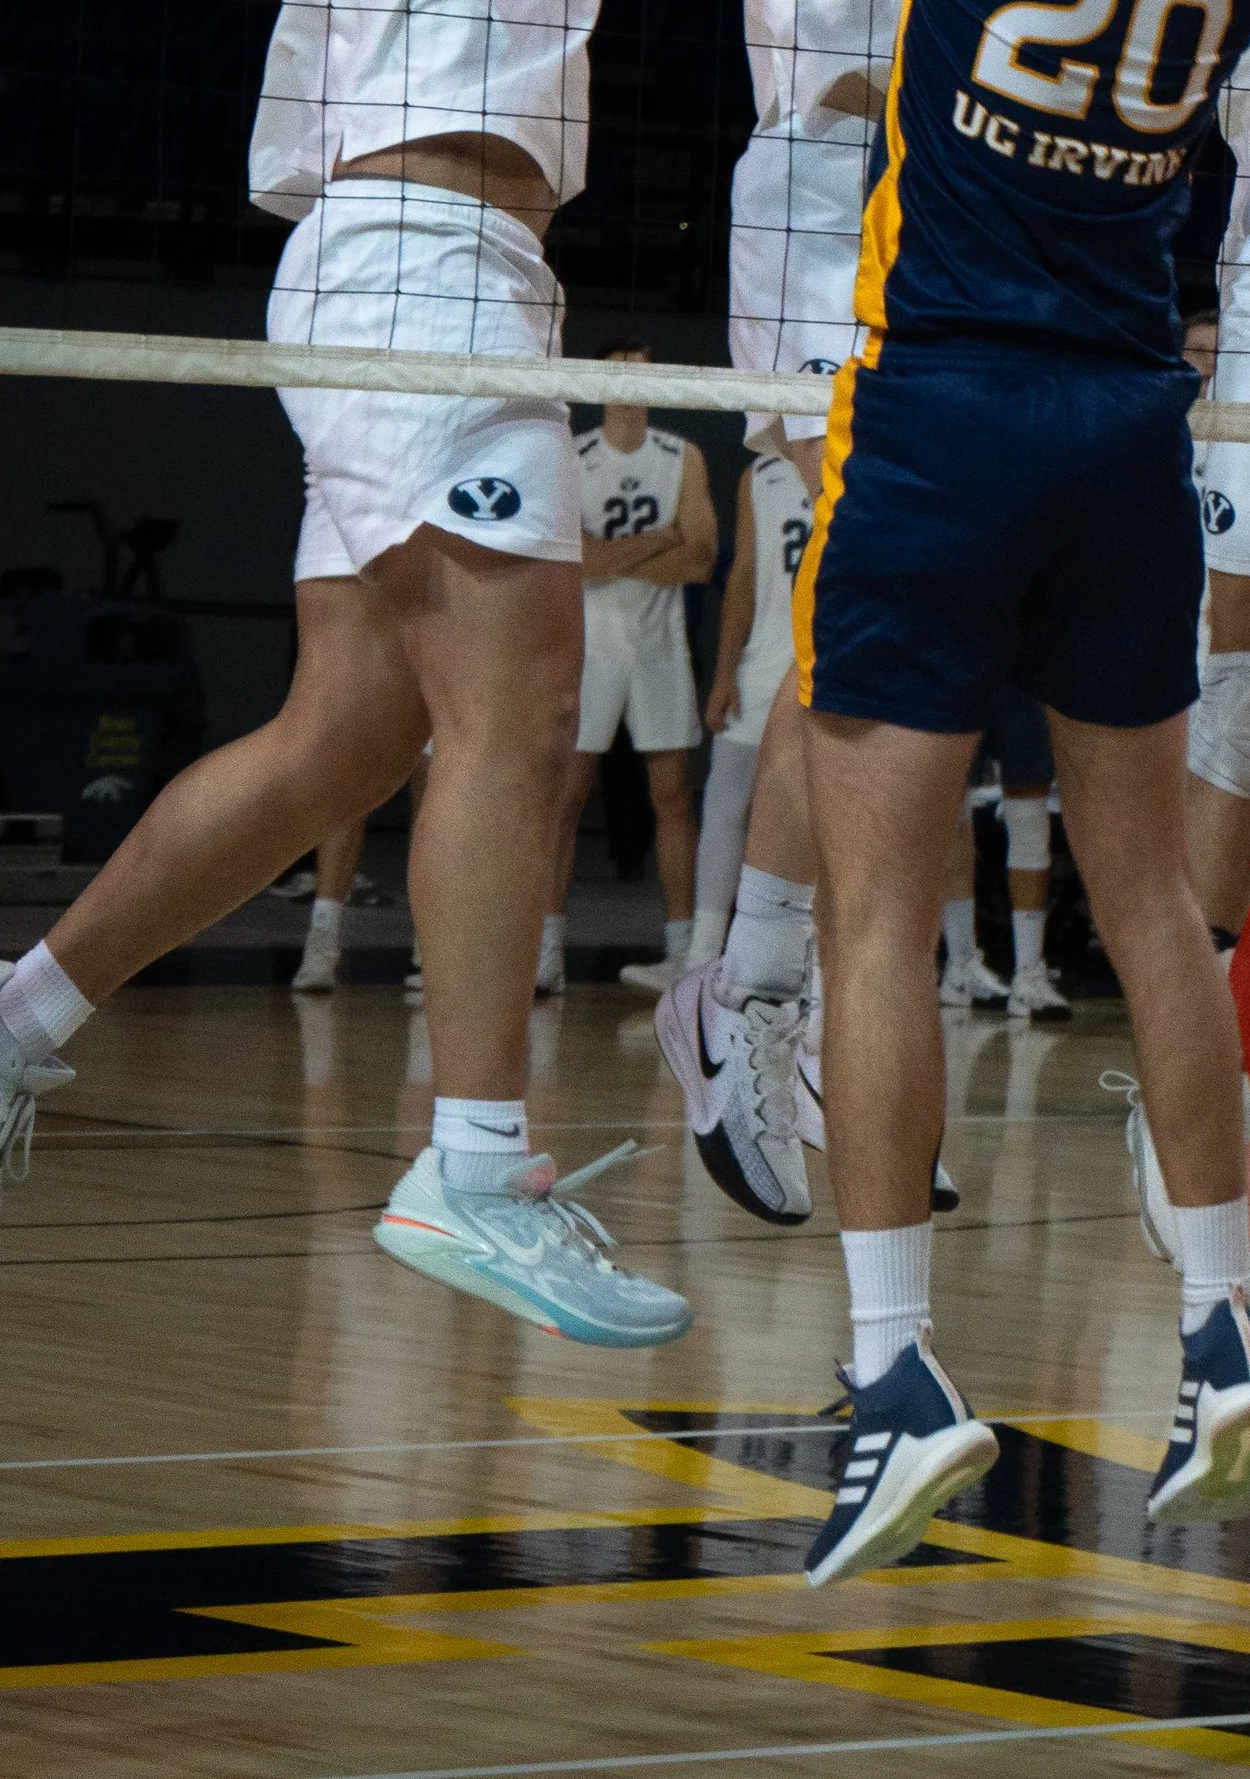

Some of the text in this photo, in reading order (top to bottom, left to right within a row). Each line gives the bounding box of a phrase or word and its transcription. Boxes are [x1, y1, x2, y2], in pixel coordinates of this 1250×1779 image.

[951, 88, 1192, 187] UC IRVIN
[456, 478, 514, 521] Y
[603, 495, 660, 541] 22
